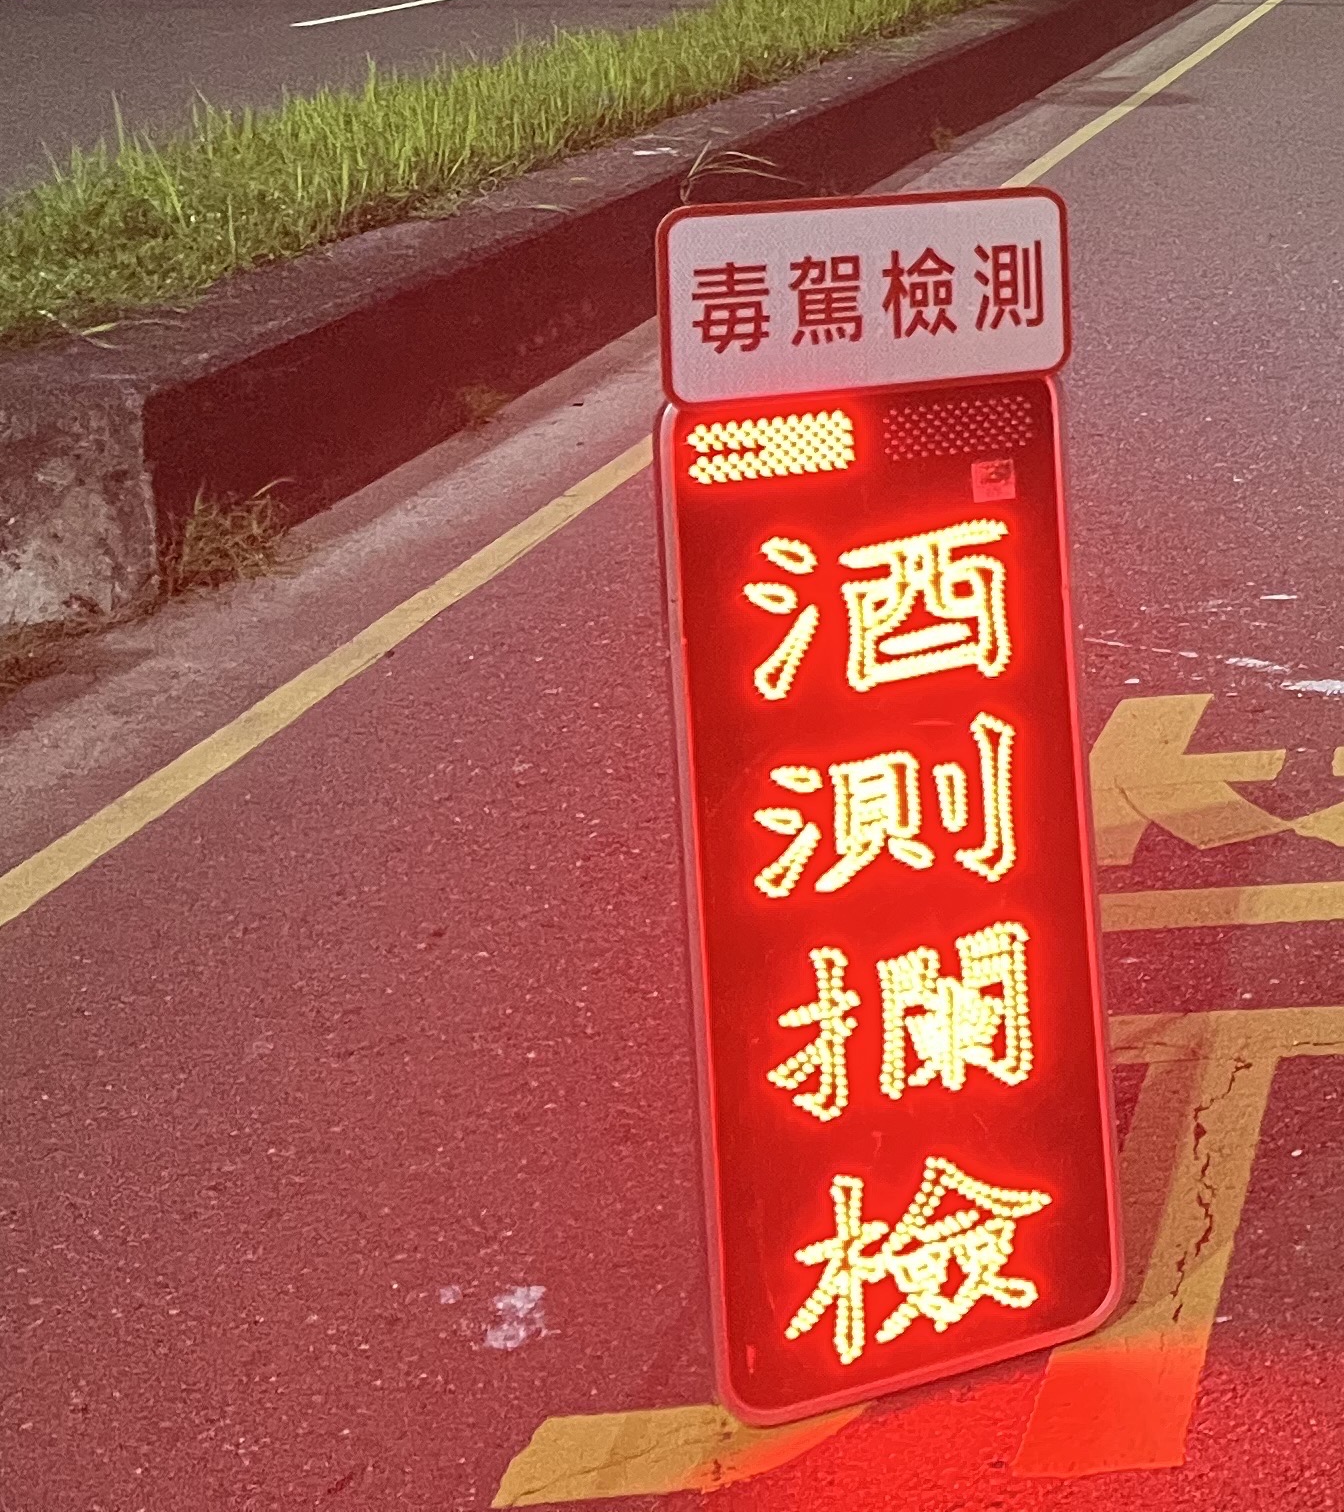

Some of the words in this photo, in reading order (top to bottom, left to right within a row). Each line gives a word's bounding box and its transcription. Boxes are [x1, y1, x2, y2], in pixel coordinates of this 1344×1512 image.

[691, 239, 1045, 355] 毒駕檢測
[743, 518, 1053, 1366] 酒測攔檢
